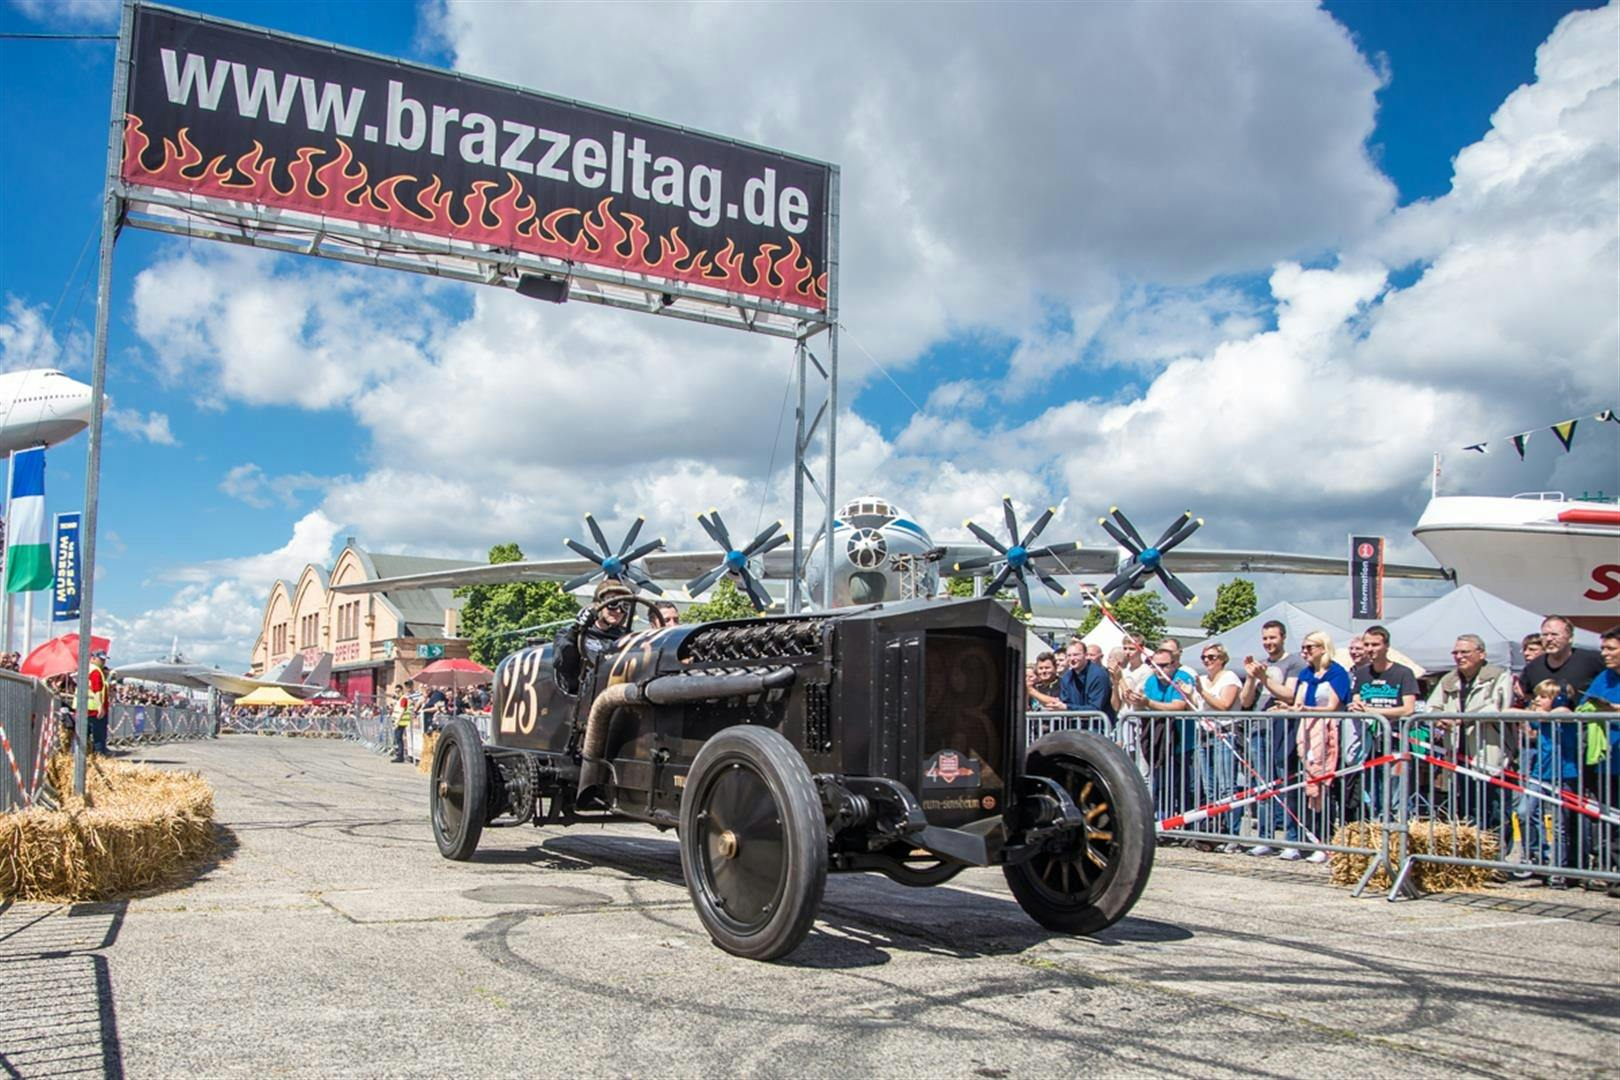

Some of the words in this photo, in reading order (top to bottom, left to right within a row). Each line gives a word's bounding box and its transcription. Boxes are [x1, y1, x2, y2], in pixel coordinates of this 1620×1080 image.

[160, 47, 809, 234] www.brazzeltag.de
[57, 536, 69, 602] MUSEUM
[66, 541, 76, 595] SPEYER
[1360, 560, 1369, 614] Information
[500, 647, 544, 735] 23
[926, 761, 938, 782] 4
